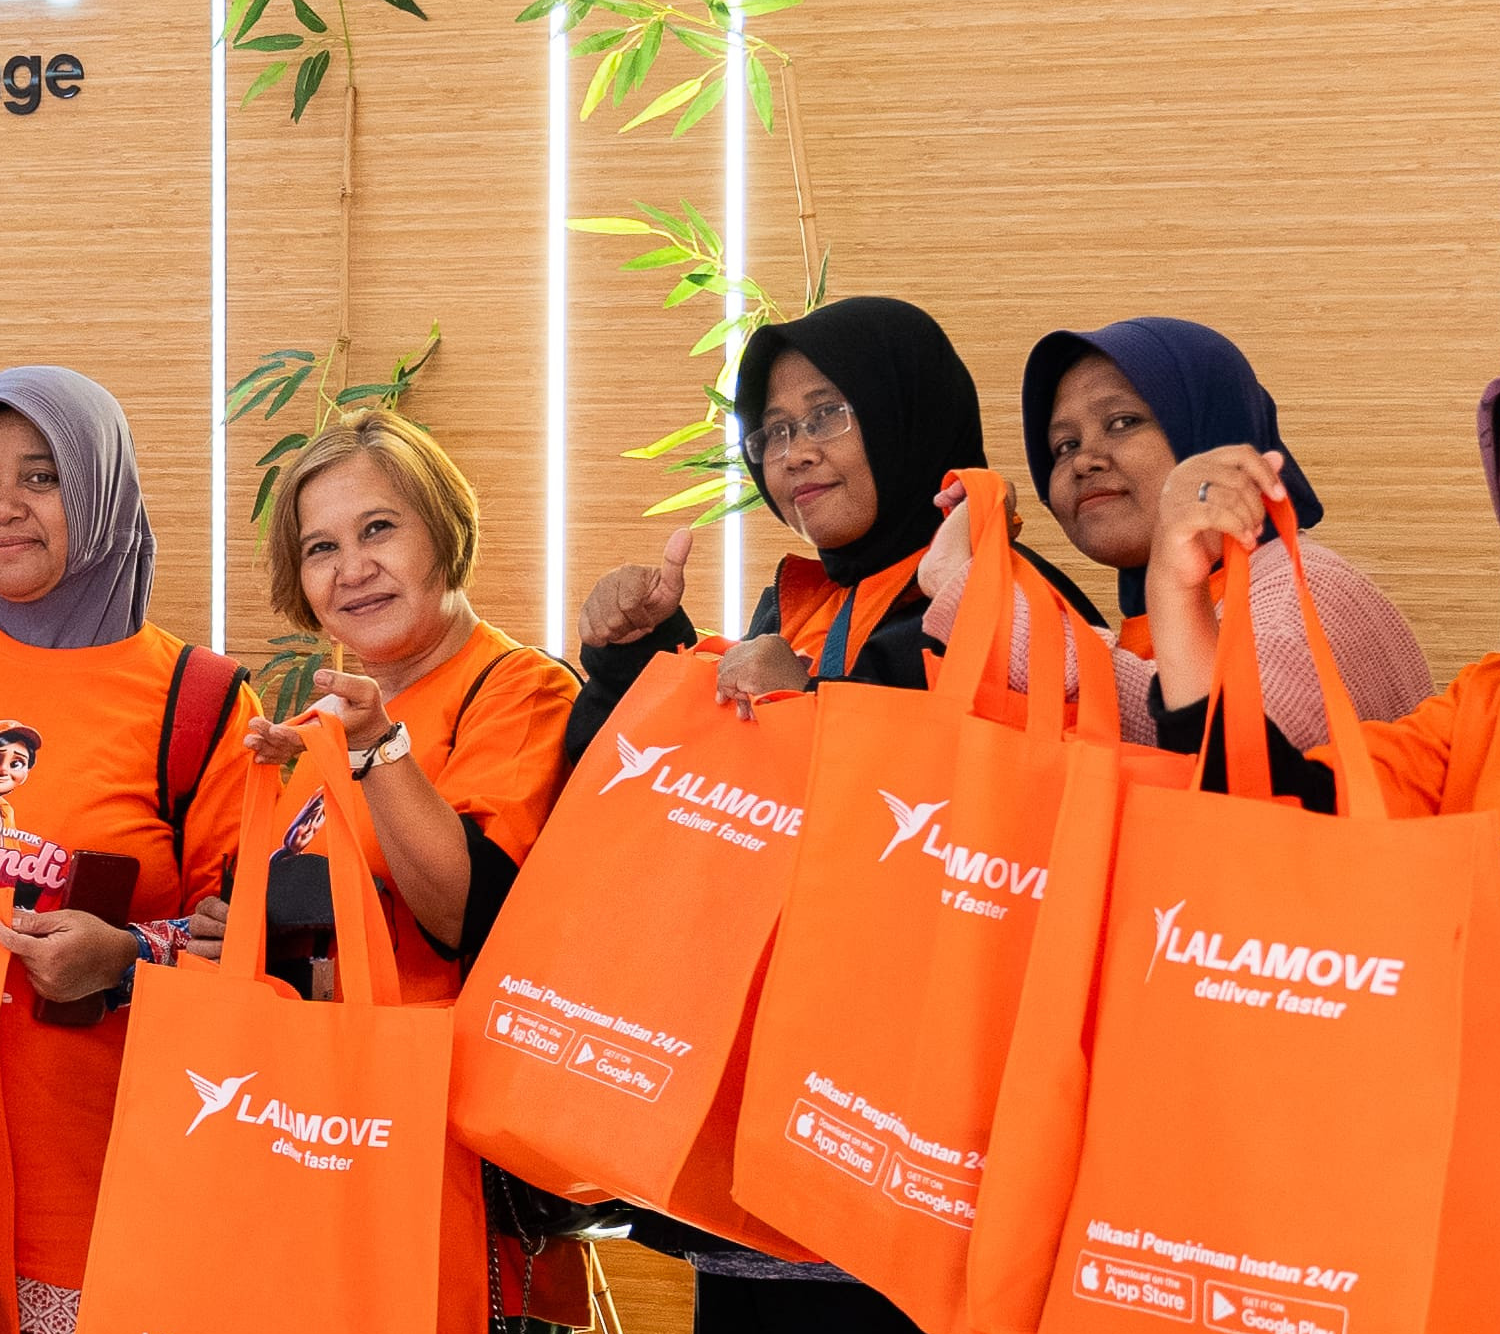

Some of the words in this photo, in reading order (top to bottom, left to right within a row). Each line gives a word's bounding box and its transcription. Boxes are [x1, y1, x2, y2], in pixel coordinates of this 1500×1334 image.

[652, 765, 804, 837] LALAMOVE
[2, 827, 42, 845] UNTUK
[667, 806, 718, 833] deliver
[717, 823, 767, 852] faster
[953, 890, 1008, 920] faster
[1165, 926, 1405, 996] LALAMOVE
[1194, 977, 1272, 1008] deliver
[1275, 989, 1347, 1019] faster
[510, 1025, 526, 1044] App
[526, 1029, 559, 1055] Store
[542, 989, 614, 1028] Pengiriman
[613, 1016, 653, 1043] Instan
[652, 1032, 693, 1057] 24/7
[596, 1058, 633, 1083] Google
[632, 1071, 656, 1093] Play
[304, 1150, 353, 1171] faster
[813, 1130, 838, 1155] App
[838, 1142, 873, 1173] Store
[909, 1133, 962, 1165] Instan
[904, 1183, 953, 1212] Google
[954, 1200, 976, 1219] Pla
[1142, 1232, 1237, 1271] Pengiriman
[1240, 1254, 1302, 1283] Instan
[1304, 1266, 1358, 1292] 24/7
[1105, 1276, 1140, 1302] App
[1143, 1285, 1185, 1310] Store
